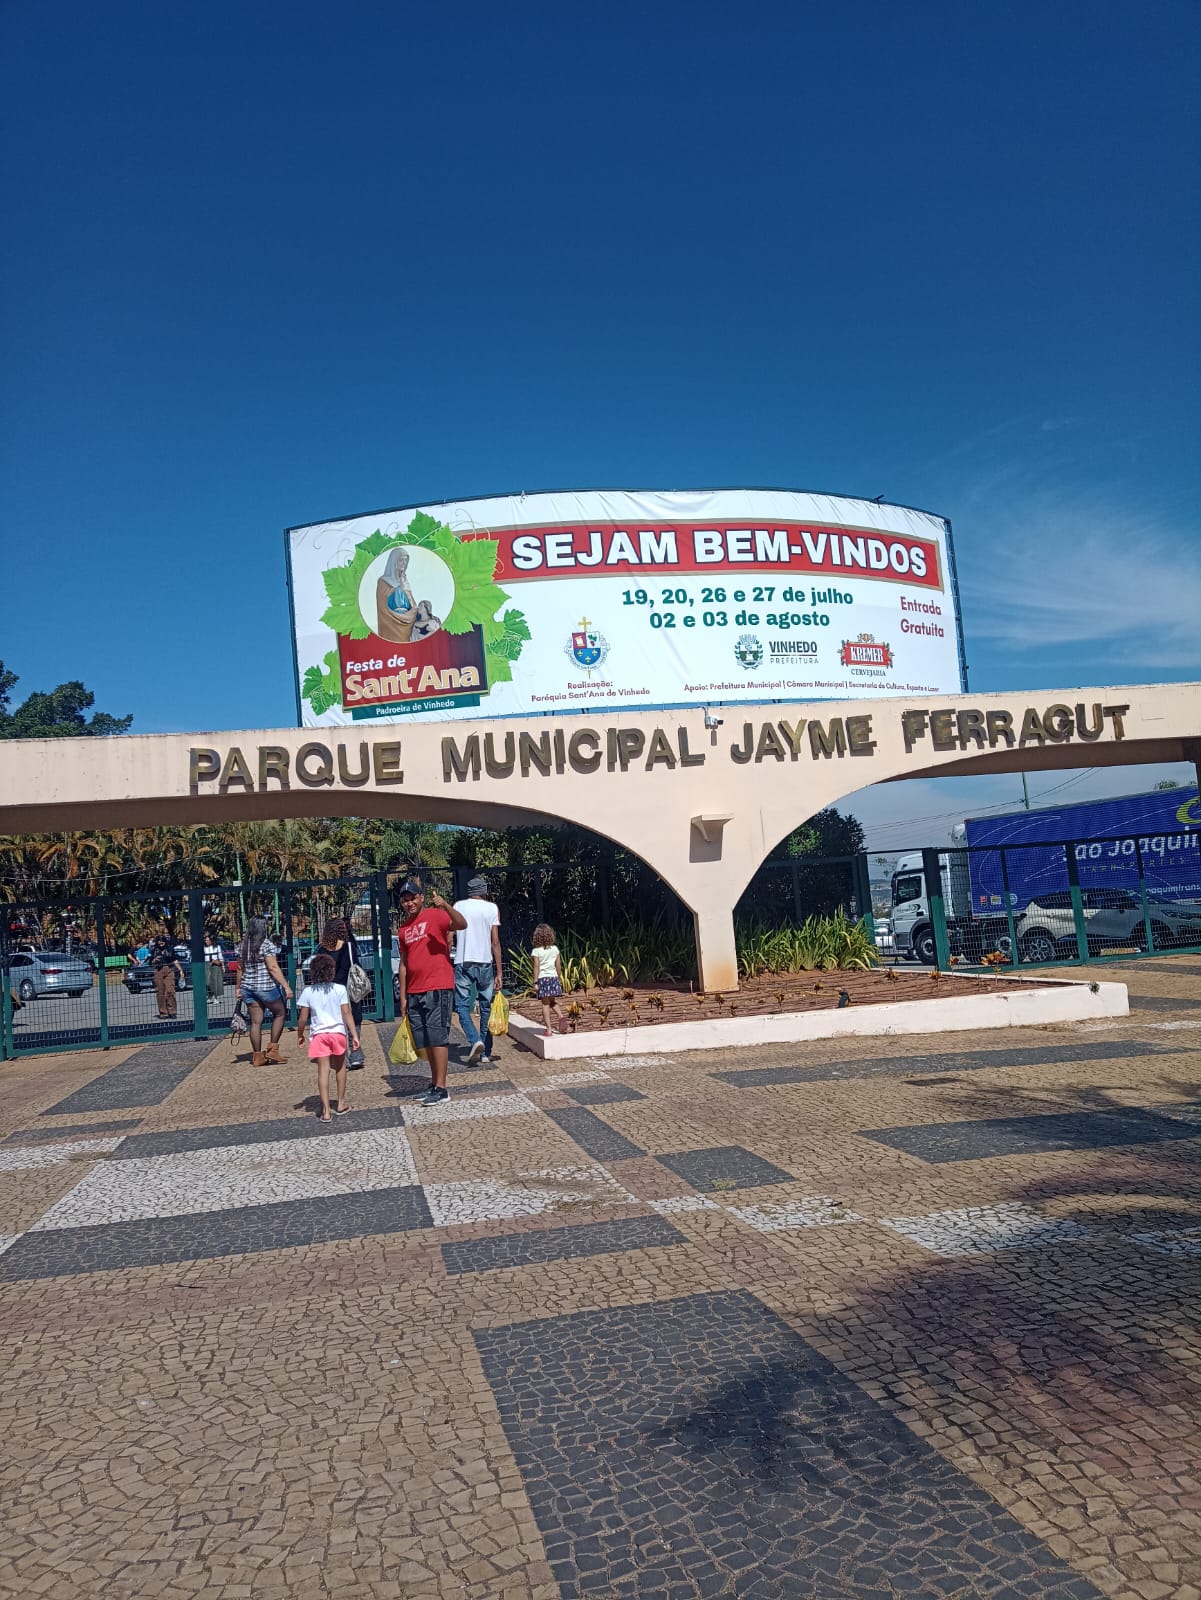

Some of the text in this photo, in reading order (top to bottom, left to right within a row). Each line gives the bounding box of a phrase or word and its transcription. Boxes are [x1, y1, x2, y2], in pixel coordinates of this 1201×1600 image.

[512, 529, 928, 577] SEJAM BEM-VINDOS
[622, 586, 854, 608] 19, 20, 26 e 27 de julho
[900, 596, 942, 617] Entrada
[650, 610, 831, 630] 02 e 03 de agosto
[900, 619, 945, 638] Gratuita
[769, 641, 818, 653] VINHEDO
[346, 654, 407, 674] Festa de
[770, 657, 819, 665] PREFEITURA
[345, 665, 481, 701] Sant'Ana
[684, 684, 708, 692] Apoio:
[709, 682, 746, 690] Prefeitura
[747, 680, 782, 689] Municipal
[786, 680, 813, 688] Câmara
[814, 681, 845, 689] Municipal
[531, 688, 651, 702] Paróquia Sant'Ana de Vinhedo
[375, 699, 455, 715] Padroeira de Vinhedo
[189, 703, 1130, 791] PARQUE MUNICIPAL JAYME FERRAGUT
[404, 921, 428, 940] EA7
